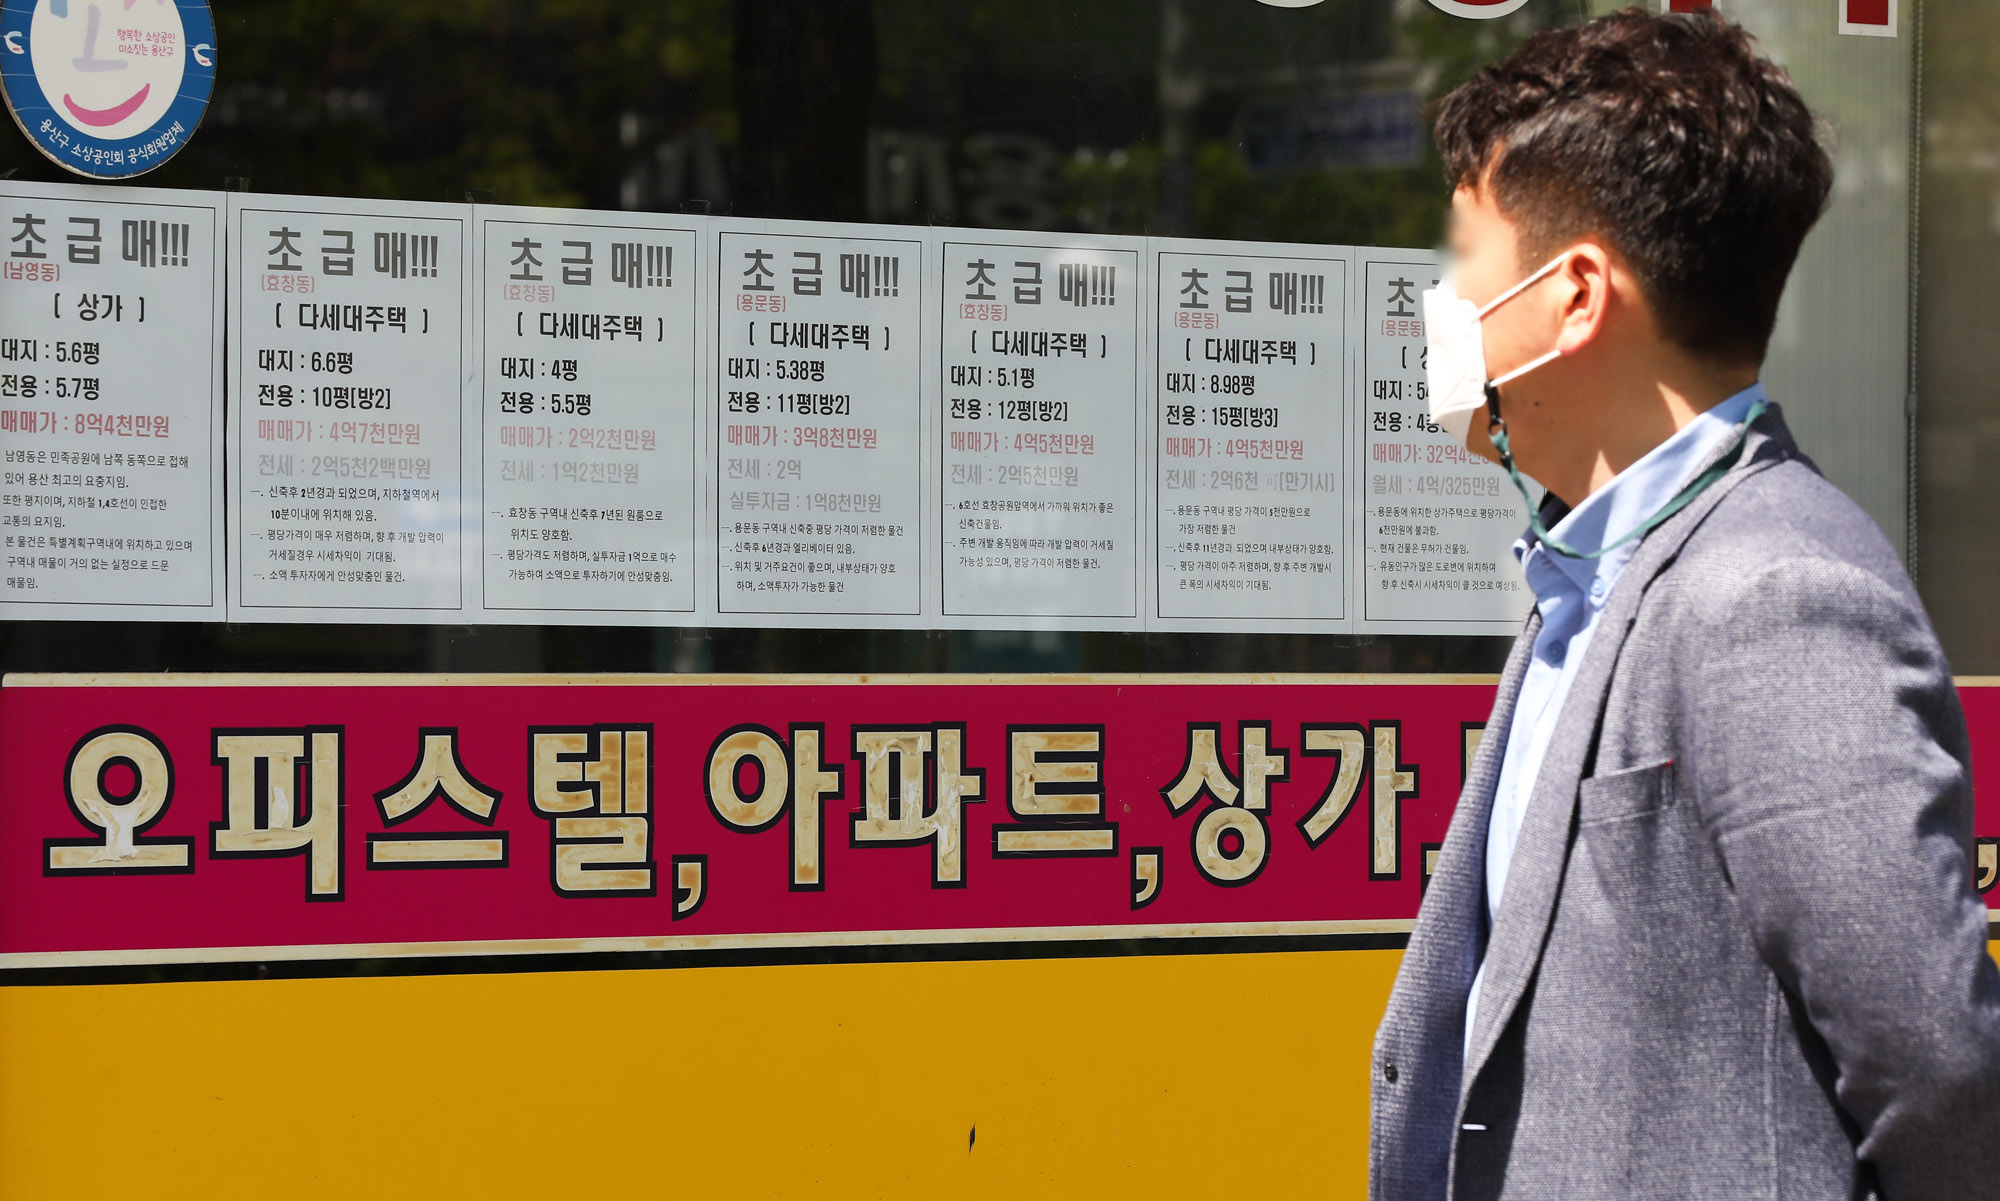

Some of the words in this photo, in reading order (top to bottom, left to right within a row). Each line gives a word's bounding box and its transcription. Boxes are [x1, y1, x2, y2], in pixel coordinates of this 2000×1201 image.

[117, 28, 142, 41] 행복한
[145, 32, 175, 44] 소상공인
[119, 44, 148, 55] 미소짓는
[152, 46, 174, 56] 용산구
[40, 119, 69, 147] 용산구
[71, 144, 124, 165] 소상공인회
[127, 120, 185, 164] 공식회원업체
[2, 338, 37, 362] 대지
[56, 341, 99, 365] 5.6평
[259, 350, 293, 372] 대지
[311, 352, 353, 374] 6.6평
[501, 357, 534, 379] 대지
[551, 359, 577, 381] 4평
[729, 358, 760, 379] 대지
[776, 360, 825, 382] 5.38평
[951, 366, 982, 387] 대지
[998, 367, 1035, 389] 5.1평
[2, 375, 37, 398] 전용
[56, 377, 99, 400] 5.7평
[1167, 373, 1195, 393] 대지
[1210, 375, 1255, 396] 8.98평
[1373, 380, 1402, 400] 대지
[258, 385, 293, 407] 전용
[501, 392, 534, 414] 전용
[551, 393, 591, 416] 5.5평
[728, 392, 760, 413] 전용
[951, 398, 982, 419] 전용
[1166, 405, 1196, 426] 전용
[1, 410, 56, 434] 매매가
[75, 414, 170, 438] 8억4천만원
[259, 420, 312, 442] 매매가
[329, 422, 421, 445] 4억7천만원
[1373, 412, 1402, 432] 전용
[501, 426, 552, 448] 매매가
[569, 428, 656, 451] 2억2천만원
[728, 425, 777, 447] 매매가
[793, 427, 877, 449] 3억8천만원
[951, 431, 998, 452] 매매가
[1014, 433, 1094, 455] 4억5천만원
[5, 451, 47, 464] 남영동은
[50, 452, 100, 466] 민족공원에
[103, 453, 123, 466] 남쪽
[126, 454, 166, 467] 동쪽으로
[169, 455, 188, 468] 접해
[1166, 438, 1211, 458] 매매가
[1226, 440, 1303, 460] 4억5천만원
[259, 454, 293, 477] 전세
[312, 456, 431, 480] 2억5천2백만원
[501, 460, 533, 482] 전세
[553, 462, 639, 484] 1억2천만원
[728, 458, 760, 479] 전세
[777, 460, 801, 480] 2억
[951, 464, 982, 485] 전세
[998, 465, 1078, 486] 2억5천만원
[4, 473, 24, 486] 있어
[28, 473, 49, 486] 용산
[52, 474, 81, 487] 최고의
[85, 475, 128, 488] 요충지임.
[1166, 469, 1195, 490] 전세
[1211, 471, 1258, 491] 2억6천
[1373, 475, 1401, 495] 월세
[1417, 476, 1499, 496] 4억/325만원
[2, 495, 21, 506] 또한
[24, 496, 65, 508] 평지이며,
[68, 497, 95, 508] 지하철
[140, 499, 167, 510] 인접한
[269, 485, 298, 499] 신축후
[300, 486, 335, 500] 2년경과
[338, 487, 380, 500] 되었으며,
[382, 488, 439, 501] 지하철역에서
[730, 491, 790, 511] 실투자금
[806, 493, 881, 513] 1억8천만원
[271, 509, 319, 521] 10분이내에
[322, 509, 351, 521] 위치해
[355, 510, 376, 521] 있음.
[509, 507, 537, 519] 효창동
[540, 507, 567, 520] 구역내
[570, 508, 598, 520] 신축후
[601, 508, 623, 520] 7년된
[626, 509, 663, 521] 원룸으로
[958, 500, 979, 511] 6호선
[982, 501, 1045, 512] 효창공원앞역에서
[1047, 502, 1070, 512] 가까워
[1072, 502, 1096, 513] 위치가
[1098, 502, 1114, 513] 좋은
[511, 528, 538, 541] 위치도
[541, 529, 572, 541] 양호함.
[1179, 524, 1194, 535] 가장
[1196, 524, 1219, 535] 저렴한
[1221, 524, 1235, 535] 물건
[1378, 525, 1412, 535] 6천만원에
[1415, 525, 1438, 535] 불과함.
[734, 542, 760, 553] 신축후
[761, 542, 791, 553] 6년경과
[792, 542, 833, 554] 엘리베이터
[836, 543, 855, 554] 있음.
[1380, 544, 1394, 553] 현재
[1397, 544, 1418, 554] 건물은
[1420, 544, 1442, 554] 무허가
[1444, 544, 1469, 554] 건물임.
[269, 570, 287, 581] 소액
[290, 570, 334, 582] 투자자에게
[337, 571, 381, 582] 안성맞춤인
[384, 571, 405, 582] 물건.
[736, 580, 756, 592] 하며,
[758, 581, 799, 592] 소액투자가
[801, 581, 826, 592] 가능한
[828, 581, 844, 592] 물건
